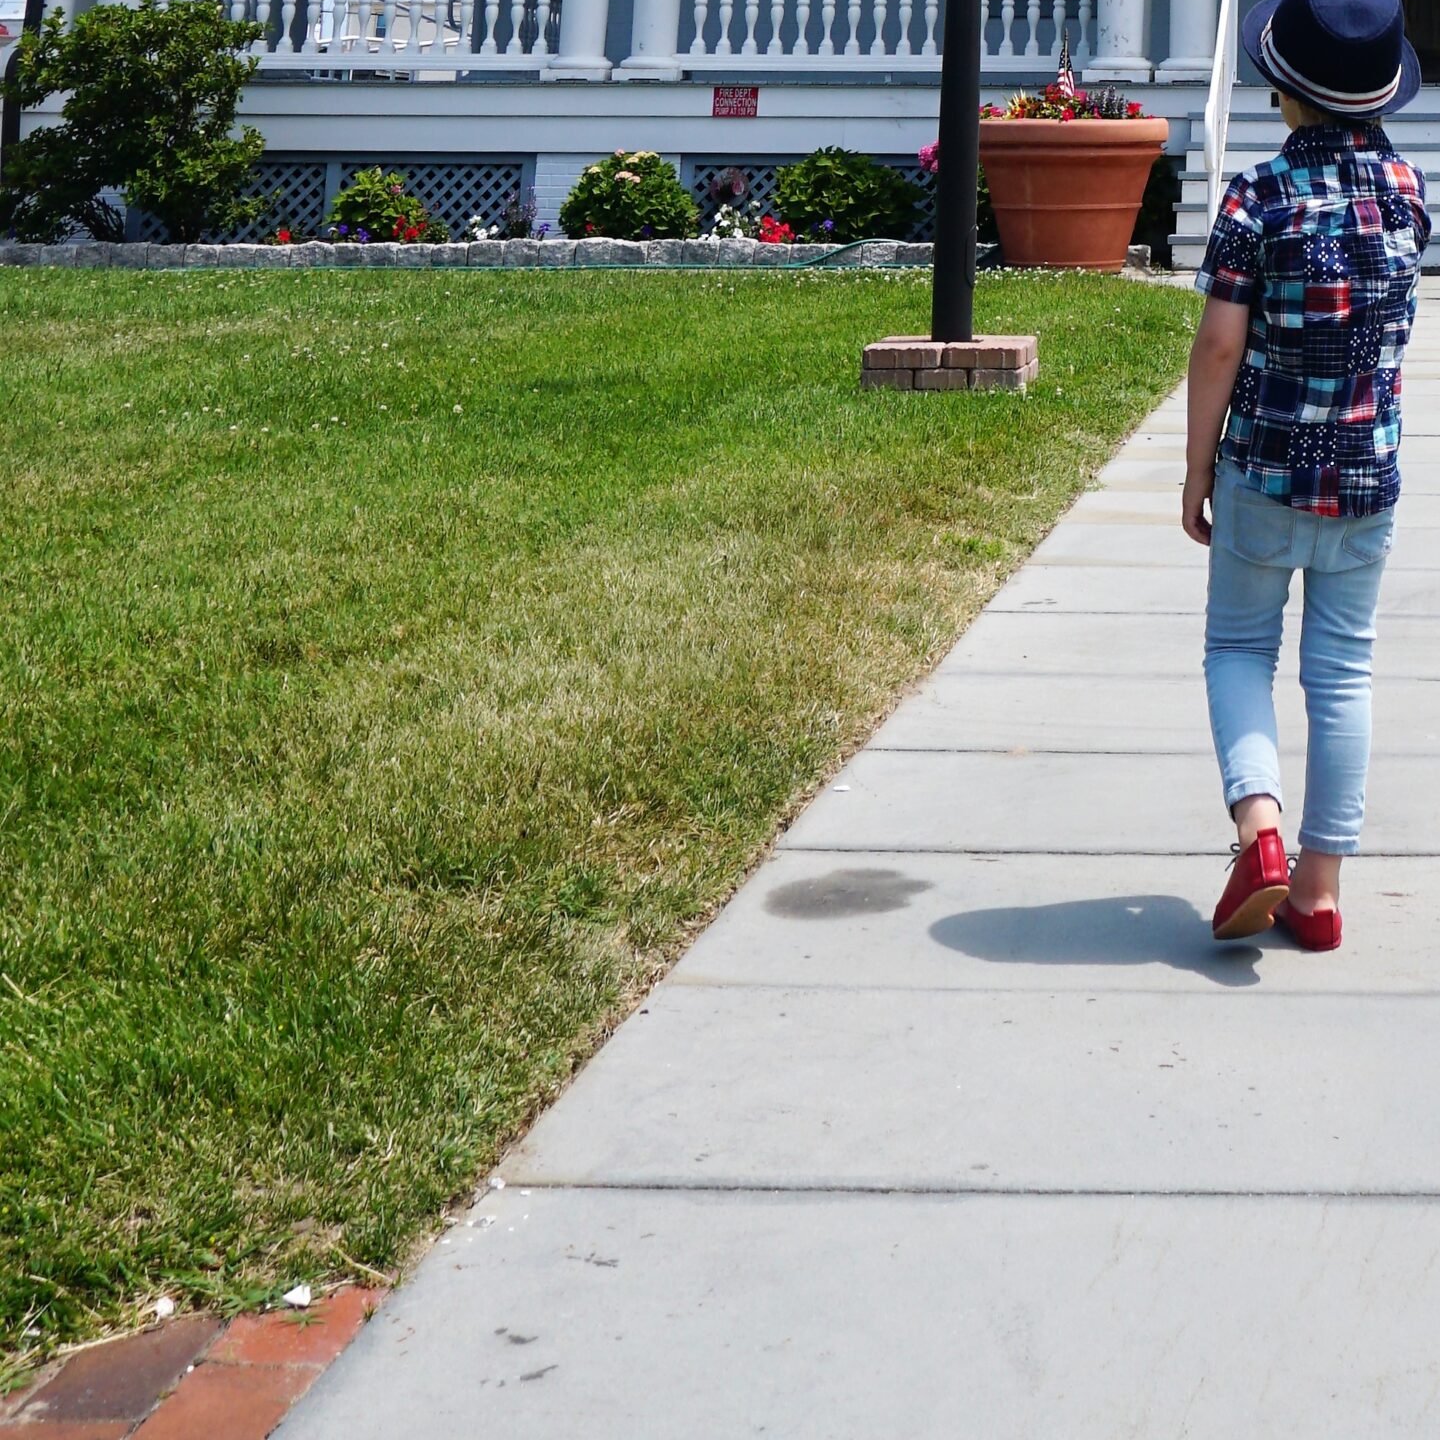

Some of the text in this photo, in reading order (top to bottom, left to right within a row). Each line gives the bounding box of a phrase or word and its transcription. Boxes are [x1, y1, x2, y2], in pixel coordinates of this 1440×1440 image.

[720, 88, 753, 97] FIRE DEPT.
[715, 97, 756, 107] CONNECTION
[730, 107, 737, 115] AT
